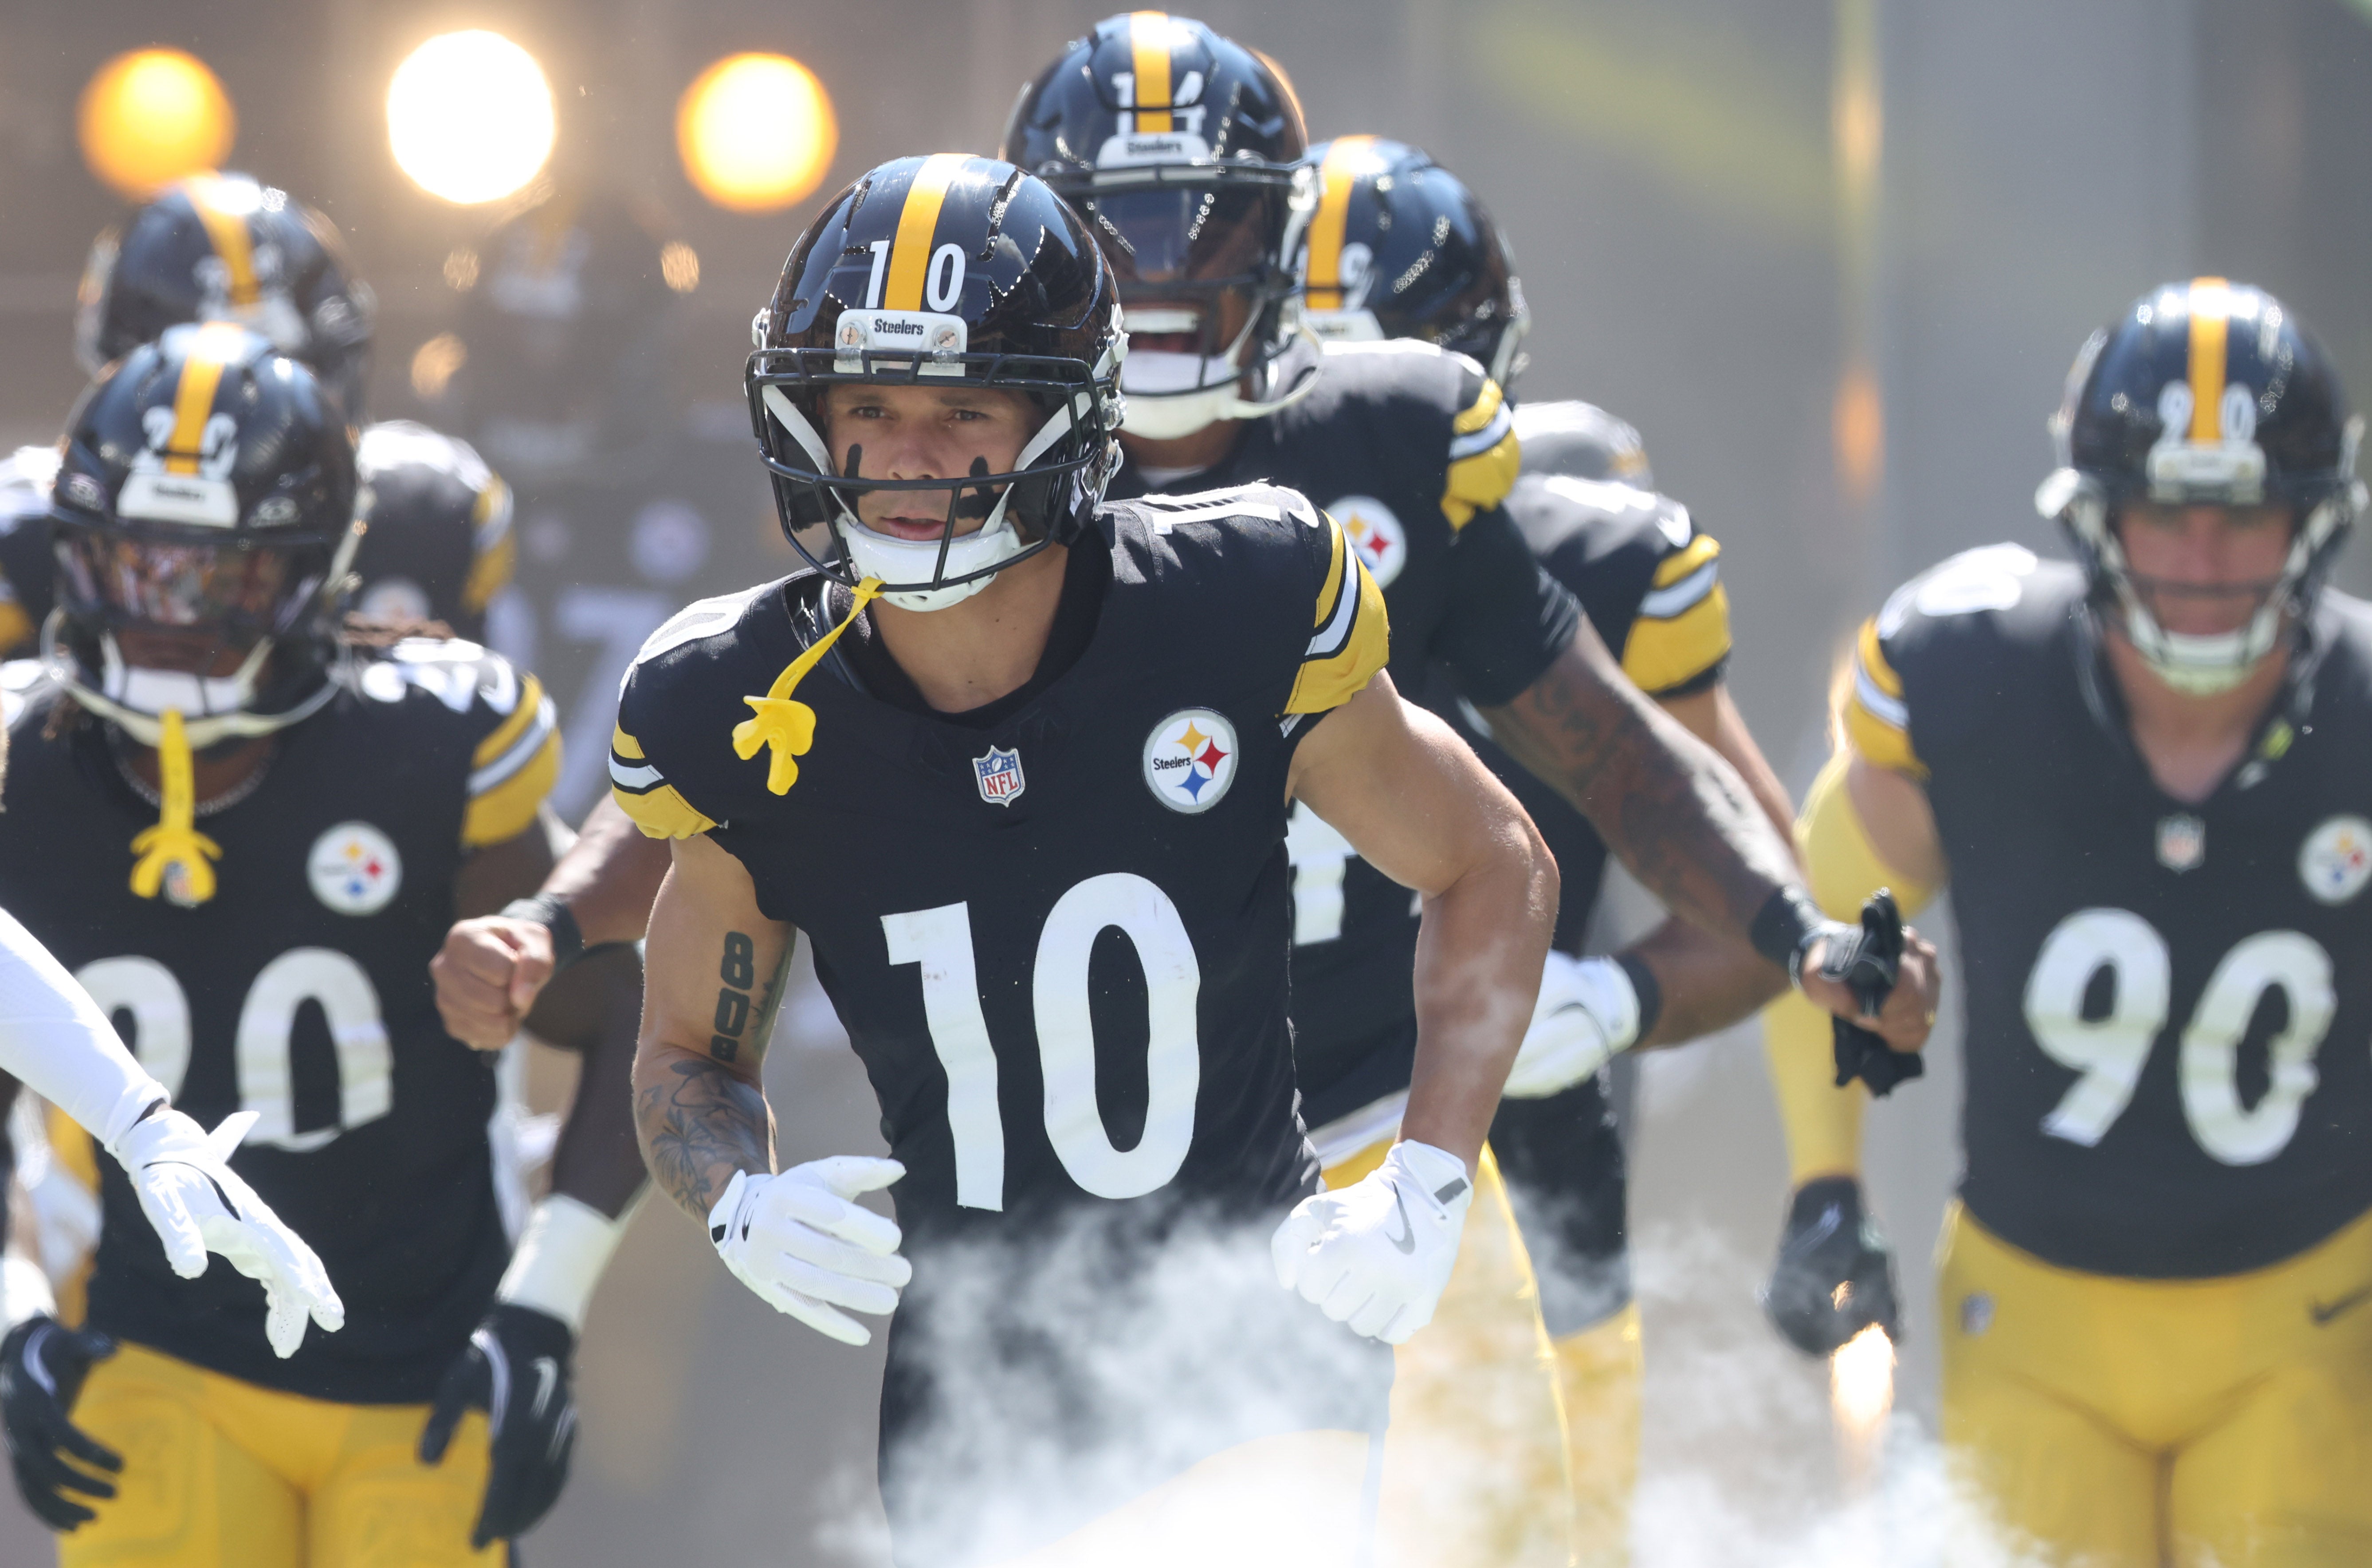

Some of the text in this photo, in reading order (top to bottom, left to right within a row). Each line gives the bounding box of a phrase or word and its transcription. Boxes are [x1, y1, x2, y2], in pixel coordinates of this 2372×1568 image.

[1111, 71, 1207, 135] 14
[865, 240, 966, 312] 10
[874, 318, 924, 335] Steelers
[2157, 380, 2257, 444] 90
[984, 771, 1018, 795] NFL
[1153, 756, 1191, 770] Steelers
[880, 872, 1200, 1211] 10
[2025, 908, 2337, 1166] 90
